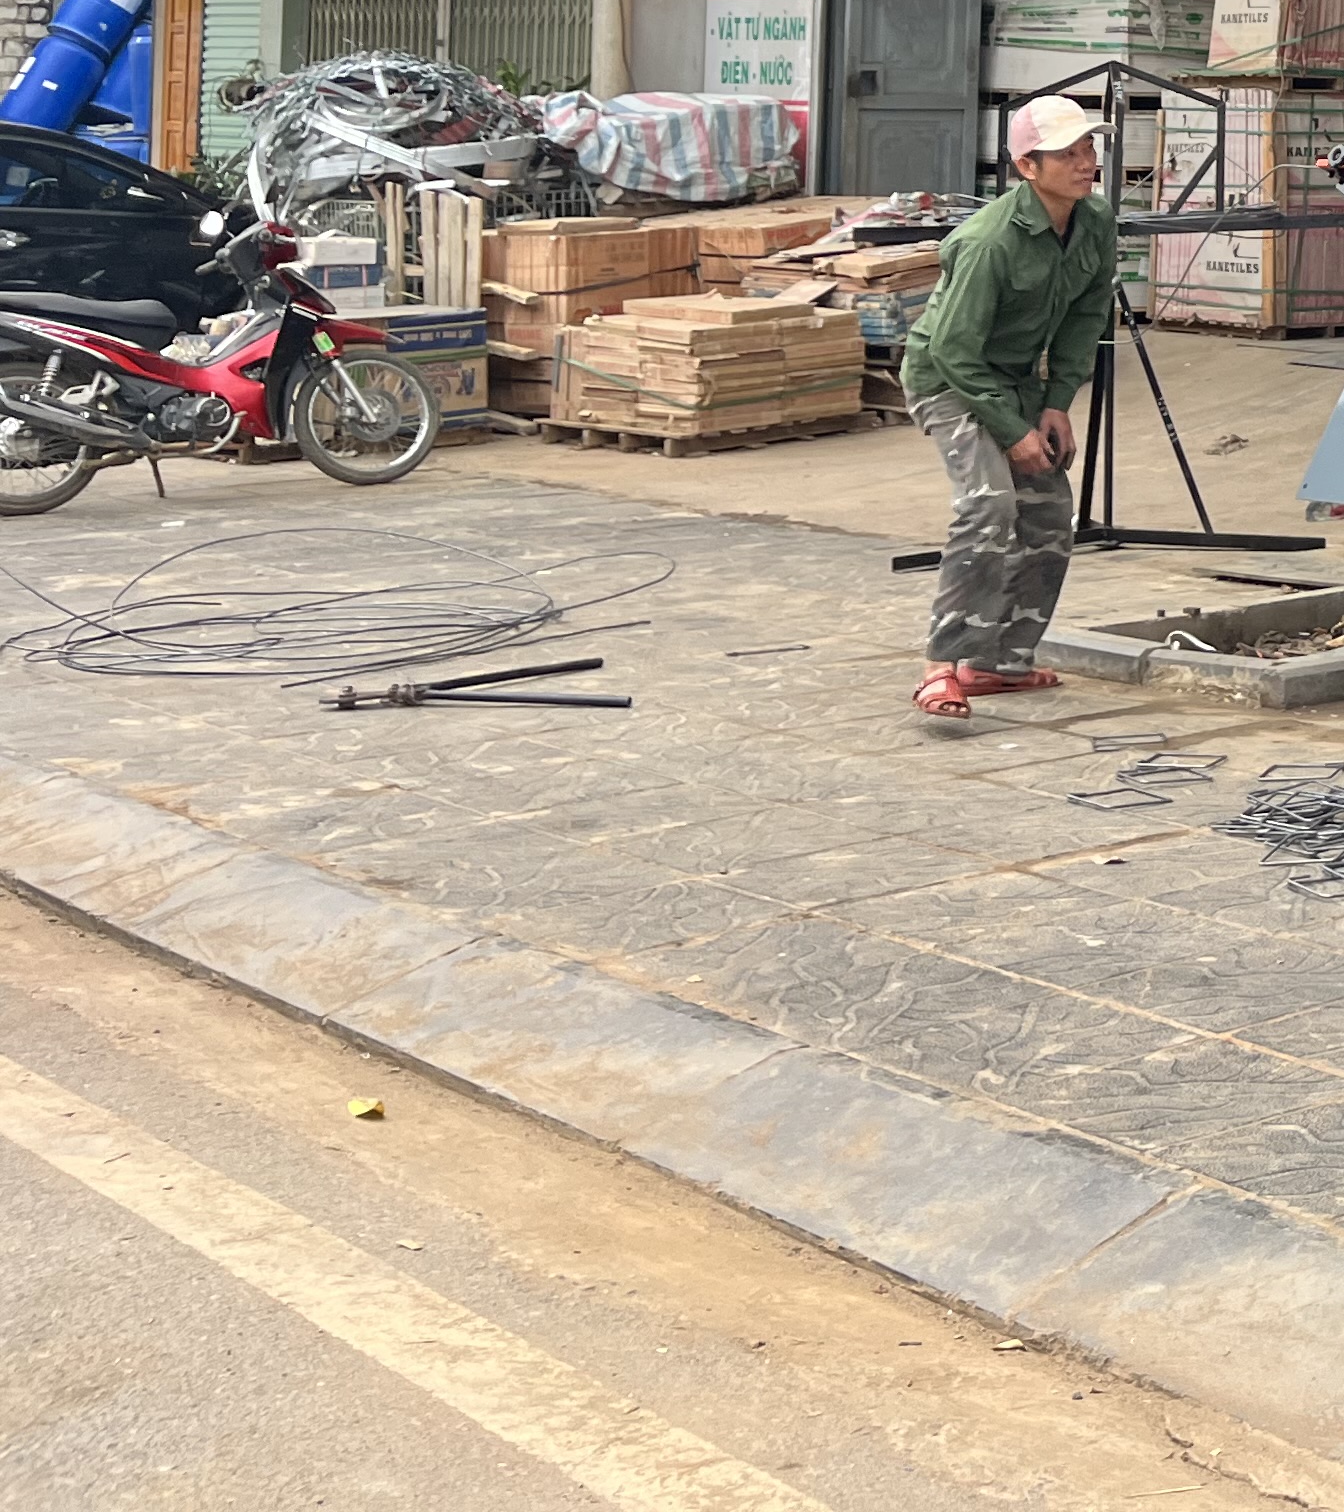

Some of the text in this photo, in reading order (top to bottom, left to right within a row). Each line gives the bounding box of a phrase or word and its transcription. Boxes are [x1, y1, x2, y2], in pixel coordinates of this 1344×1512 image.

[718, 10, 806, 47] VẬT TƯ NGÀNH
[1221, 13, 1269, 24] KANETILES
[721, 56, 749, 91] ĐIỆN
[1206, 261, 1259, 274] KANETILES
